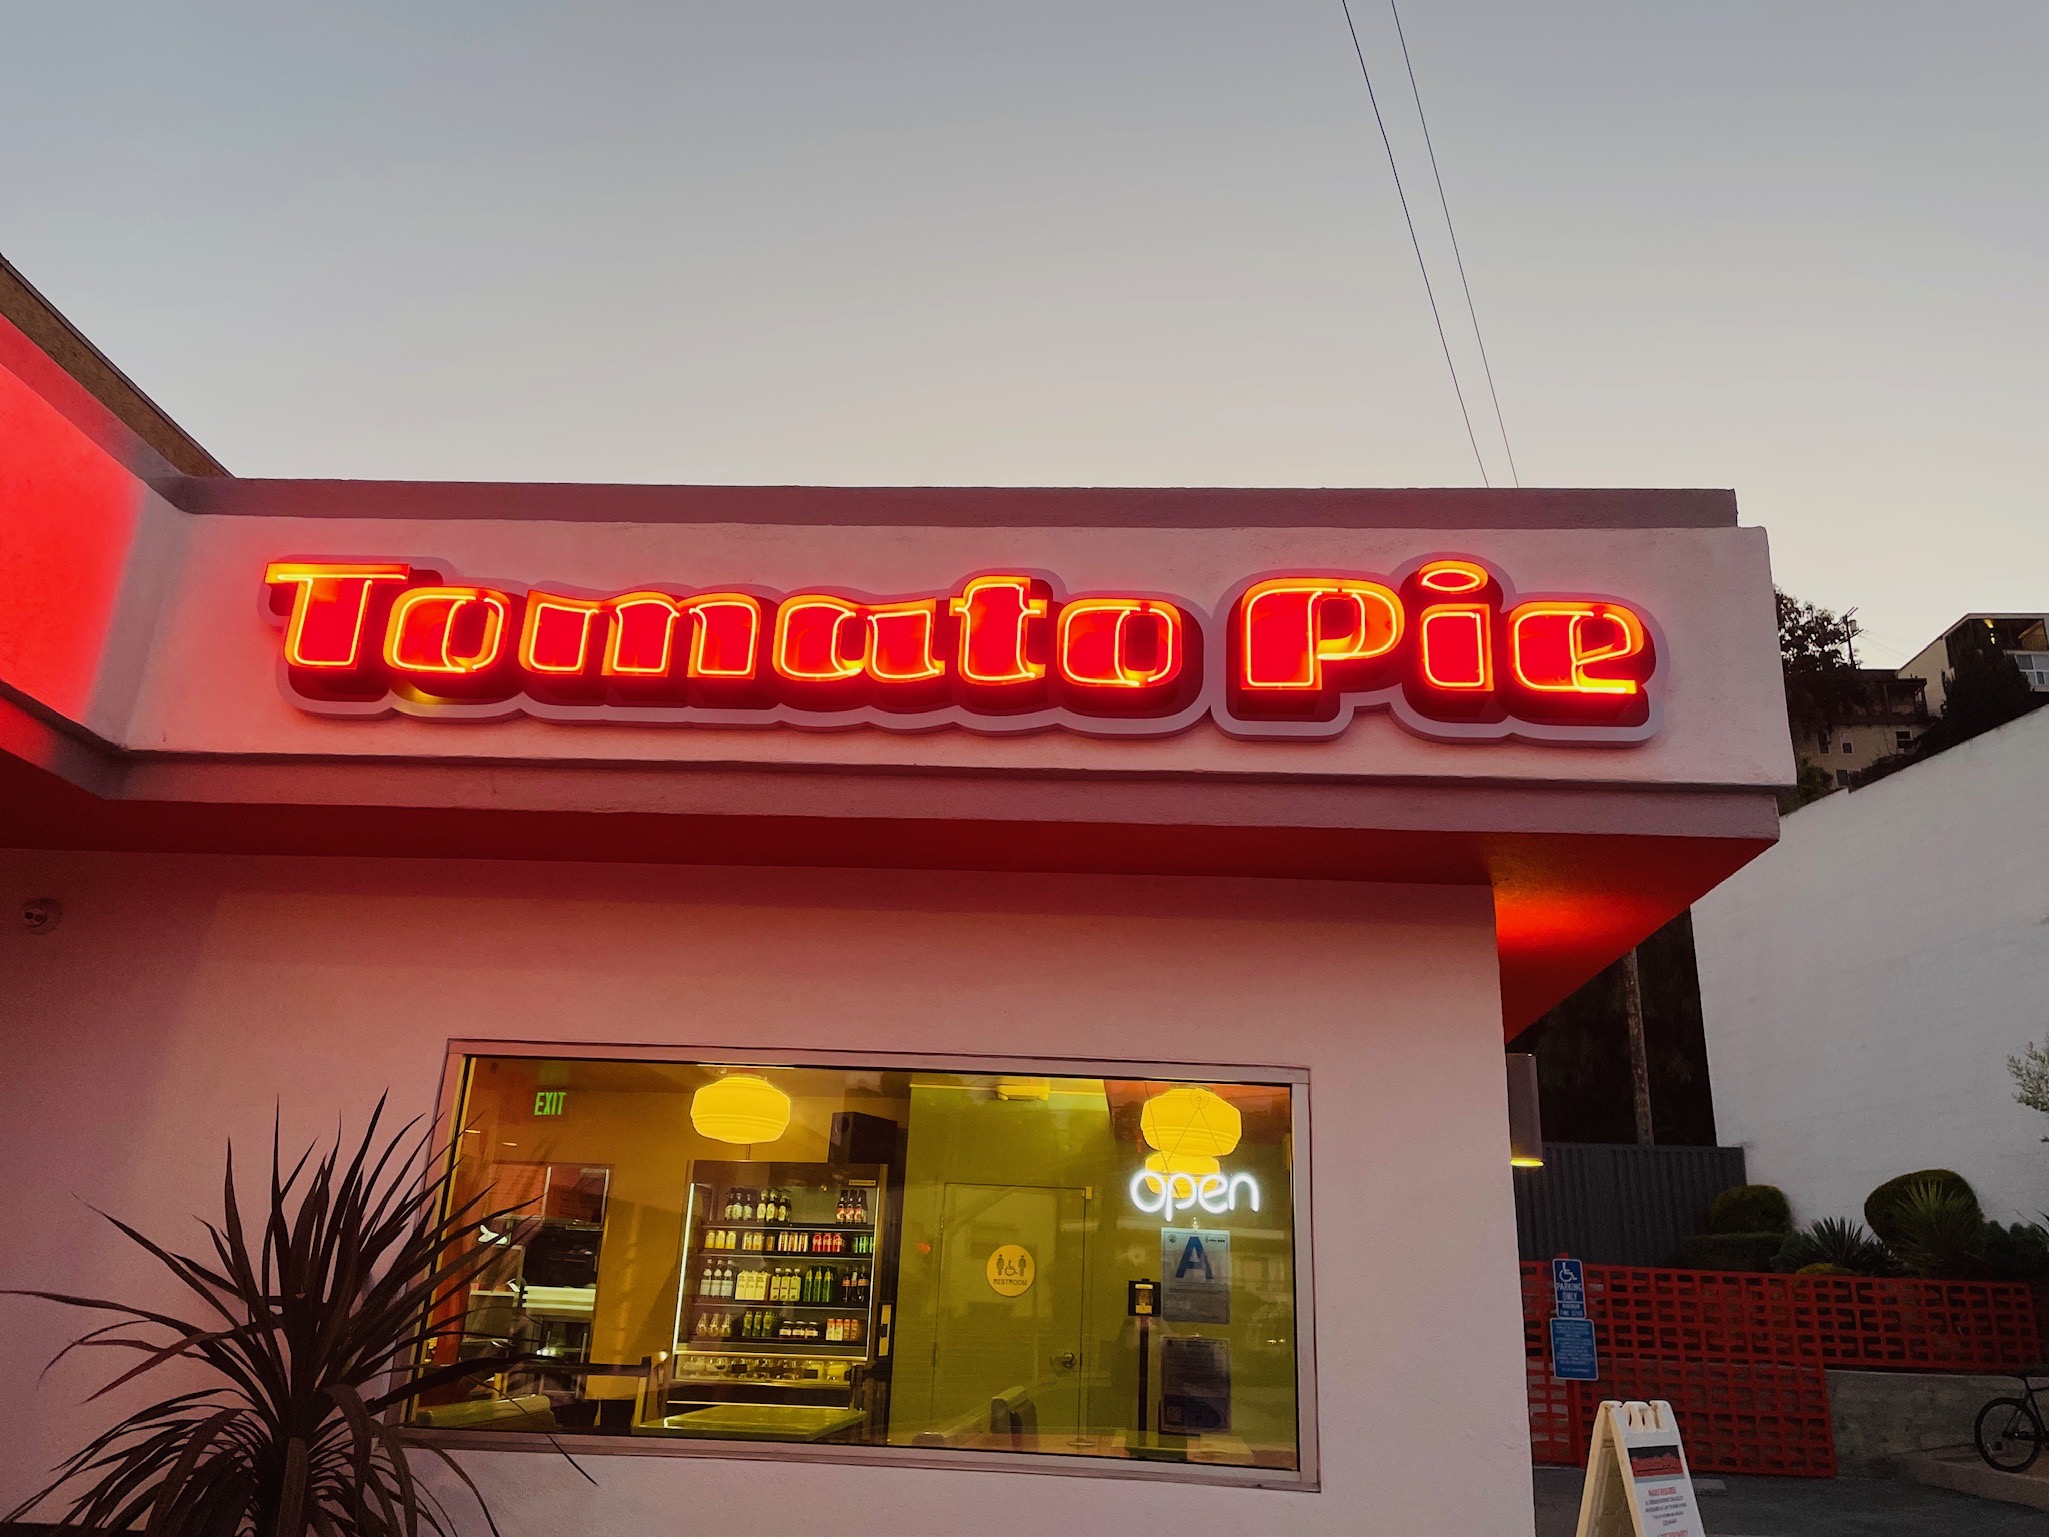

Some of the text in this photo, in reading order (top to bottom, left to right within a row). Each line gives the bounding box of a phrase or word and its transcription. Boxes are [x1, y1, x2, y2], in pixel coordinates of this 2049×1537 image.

[265, 560, 1645, 695] Tomato Pie
[533, 1091, 567, 1116] EXIT
[1128, 1168, 1262, 1223] open
[1174, 1236, 1214, 1280] A
[992, 1278, 1028, 1286] RESTROOM
[1556, 1282, 1584, 1292] PARKING
[1562, 1291, 1578, 1301] ONLY
